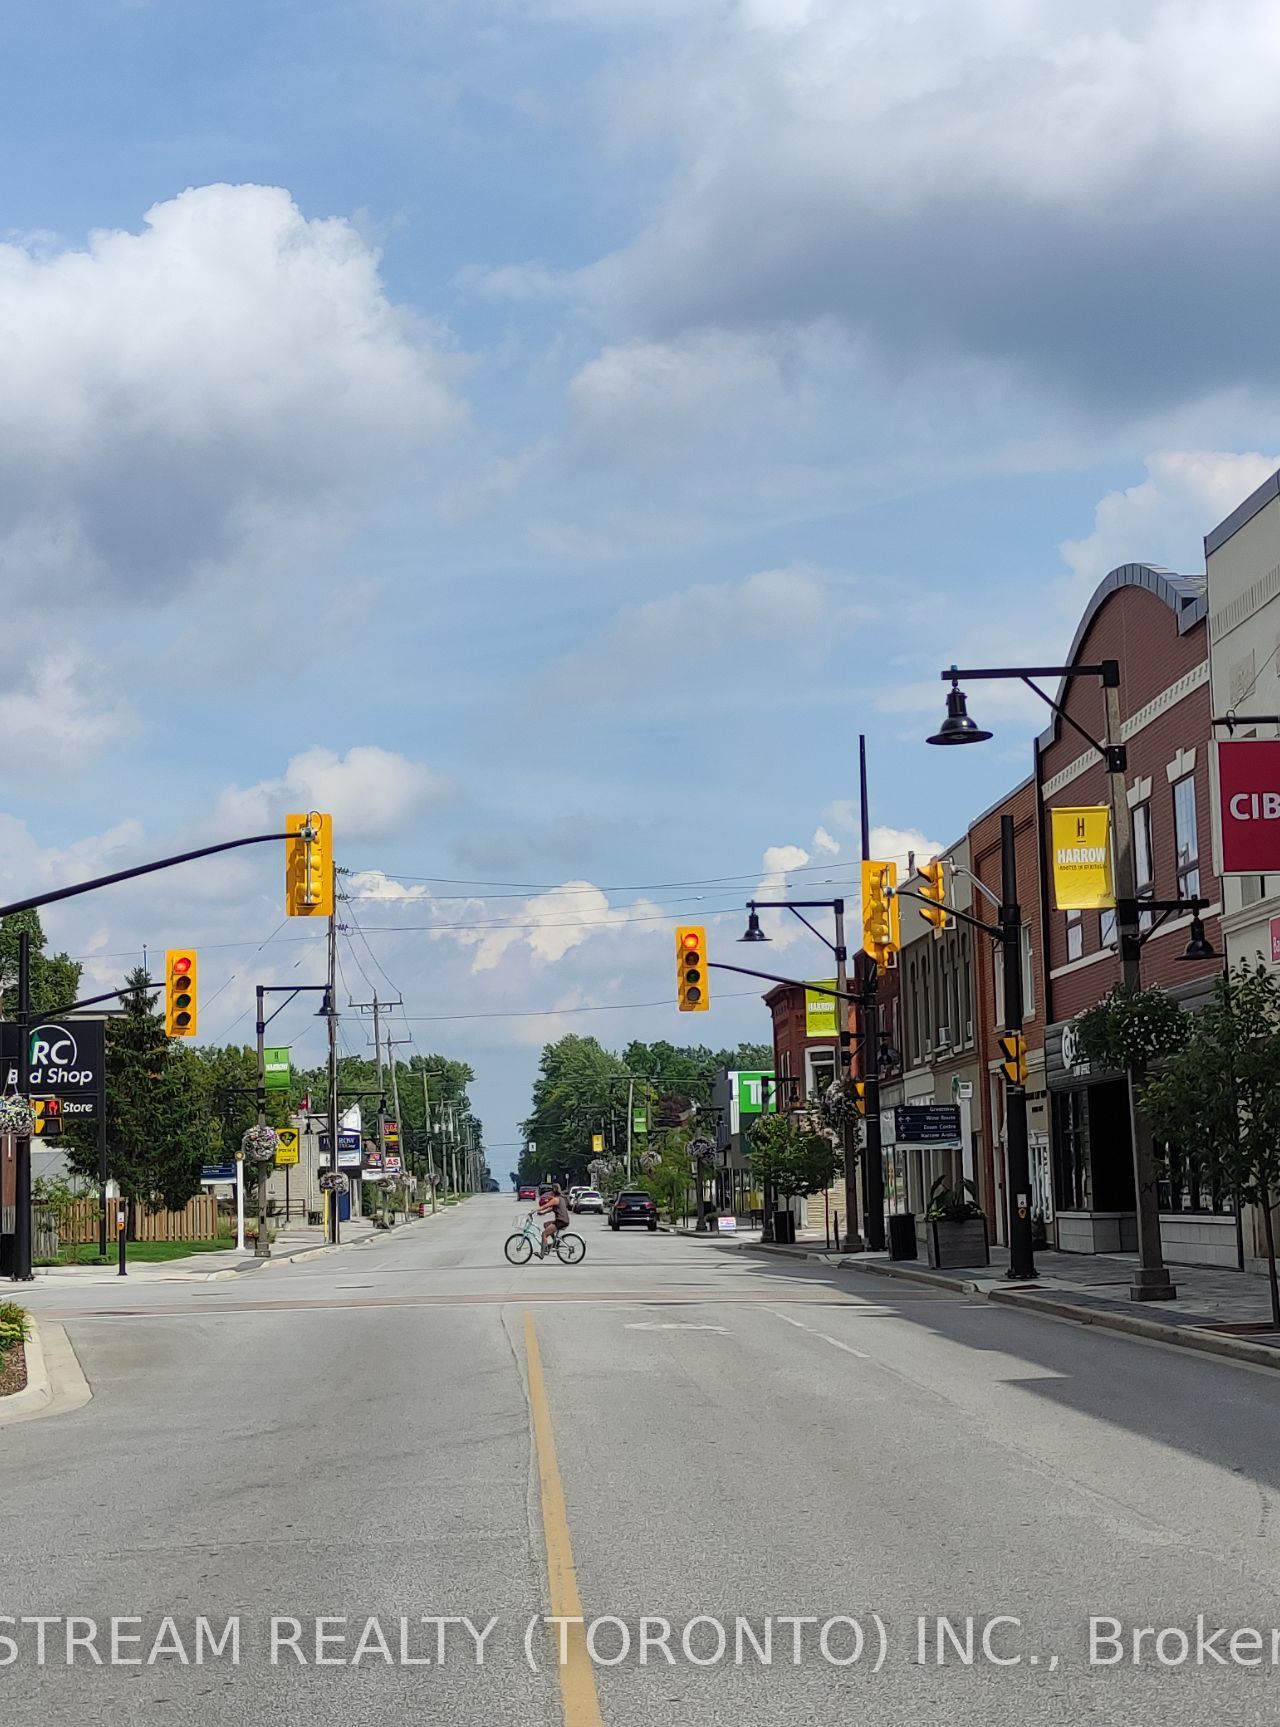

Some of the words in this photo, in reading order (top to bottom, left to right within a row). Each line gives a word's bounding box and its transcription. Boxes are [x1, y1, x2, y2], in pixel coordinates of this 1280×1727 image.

[1057, 847, 1107, 864] HARROW
[31, 1040, 71, 1066] RC
[47, 1068, 92, 1086] Shop
[63, 1102, 93, 1113] Store
